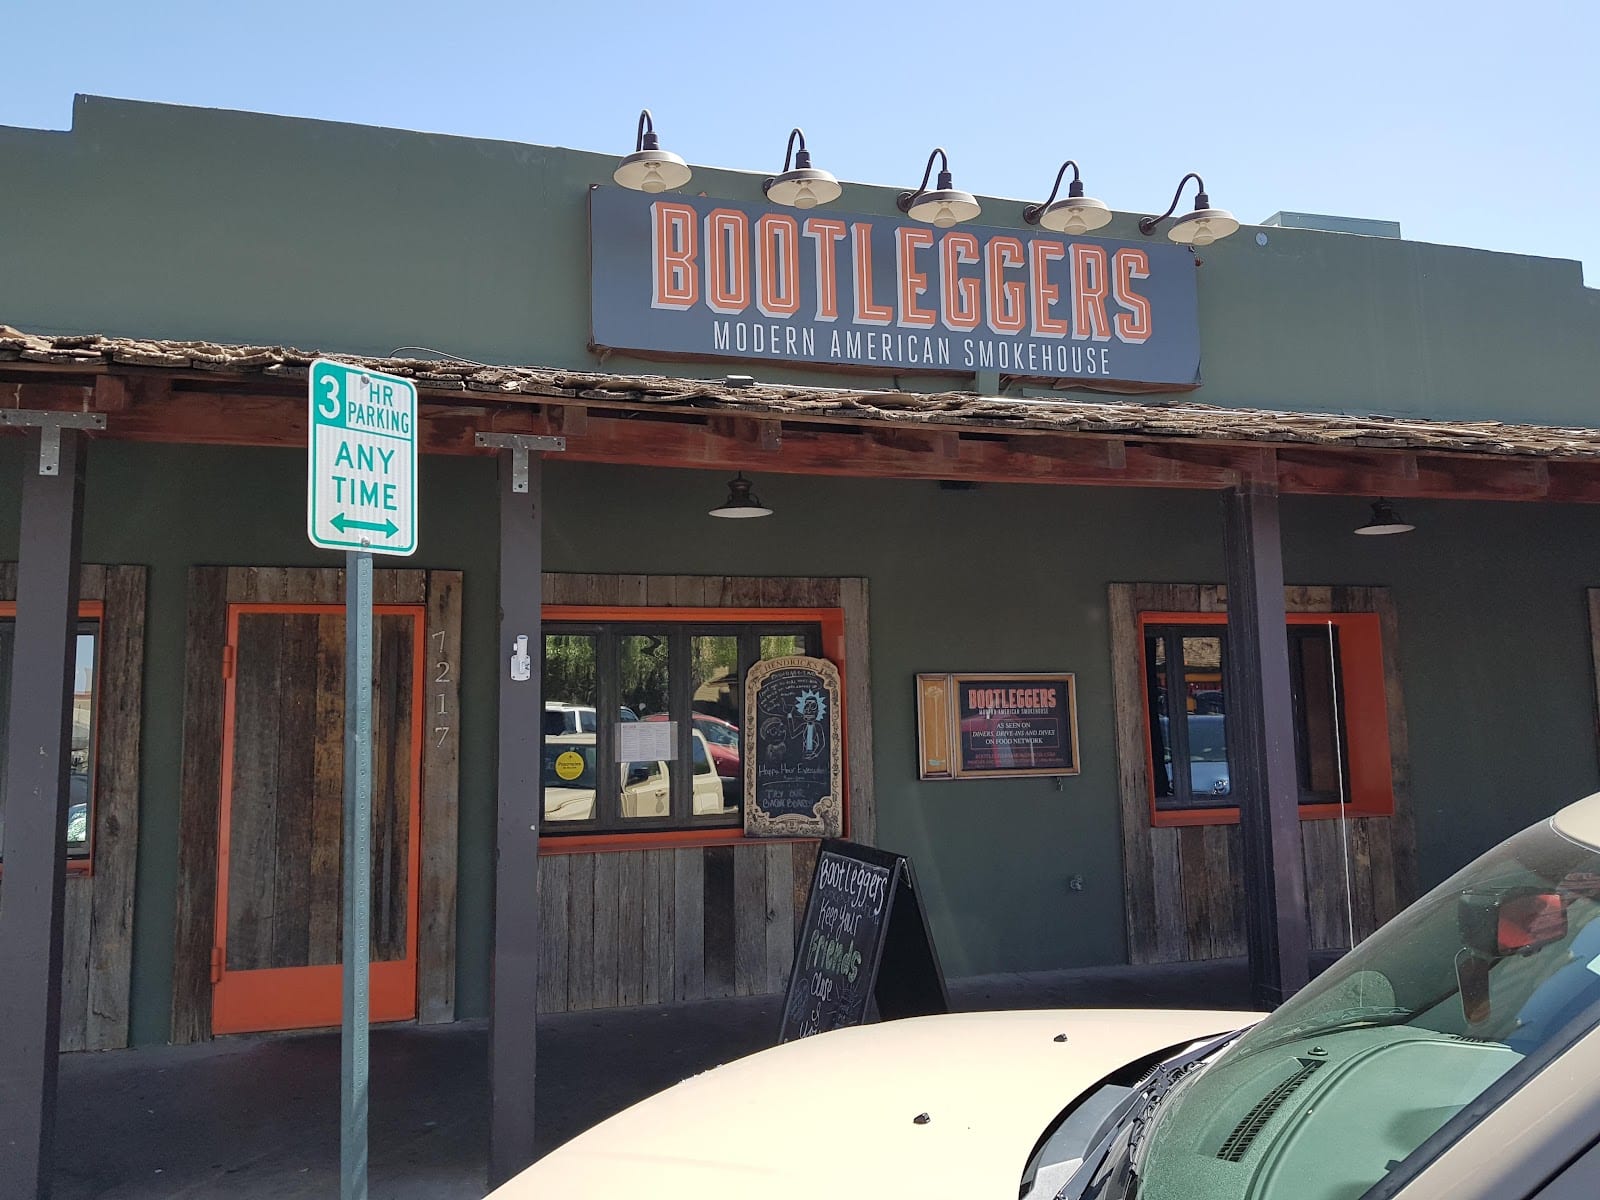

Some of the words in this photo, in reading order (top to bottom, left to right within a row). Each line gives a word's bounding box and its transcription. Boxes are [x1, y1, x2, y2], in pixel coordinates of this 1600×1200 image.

[650, 201, 1151, 344] BOOTLEGGERS
[713, 321, 815, 357] MODERN
[830, 329, 950, 365] AMERICAN
[963, 338, 1110, 375] SMOKEHOUSE
[318, 374, 341, 420] 3
[369, 382, 393, 407] HR
[348, 402, 409, 434] PARKING
[334, 441, 395, 474] ANY
[331, 476, 397, 510] TIME
[968, 688, 1057, 709] BOOTLEGGERS
[1013, 737, 1043, 745] NETWORK
[1021, 721, 1031, 729] ON
[819, 858, 888, 914] Bootleggers
[817, 898, 839, 932] Keep
